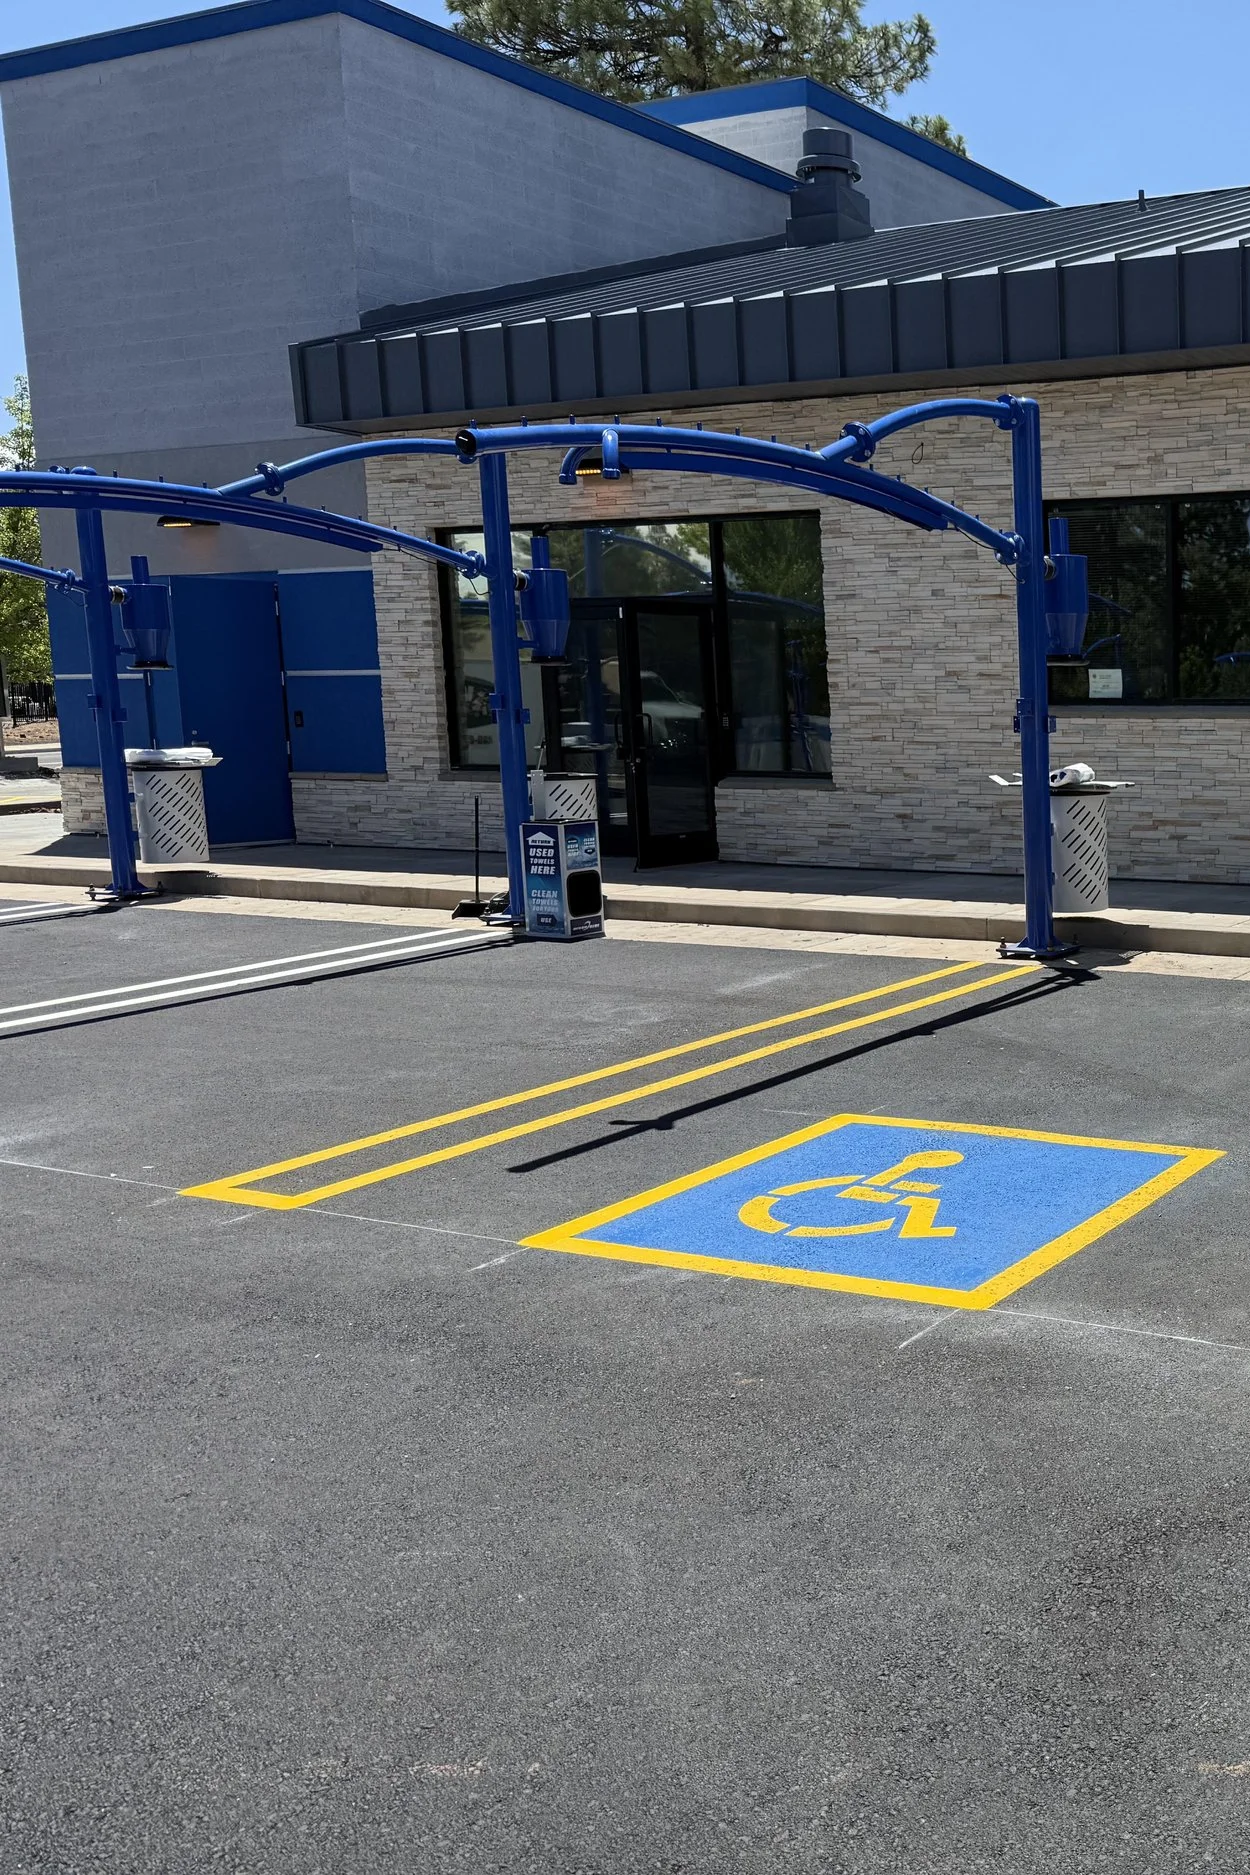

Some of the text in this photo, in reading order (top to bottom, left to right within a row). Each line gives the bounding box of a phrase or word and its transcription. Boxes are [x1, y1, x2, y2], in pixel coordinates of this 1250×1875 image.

[529, 848, 554, 857] USED
[530, 865, 556, 875] HERE
[531, 890, 558, 898] CLEAN
